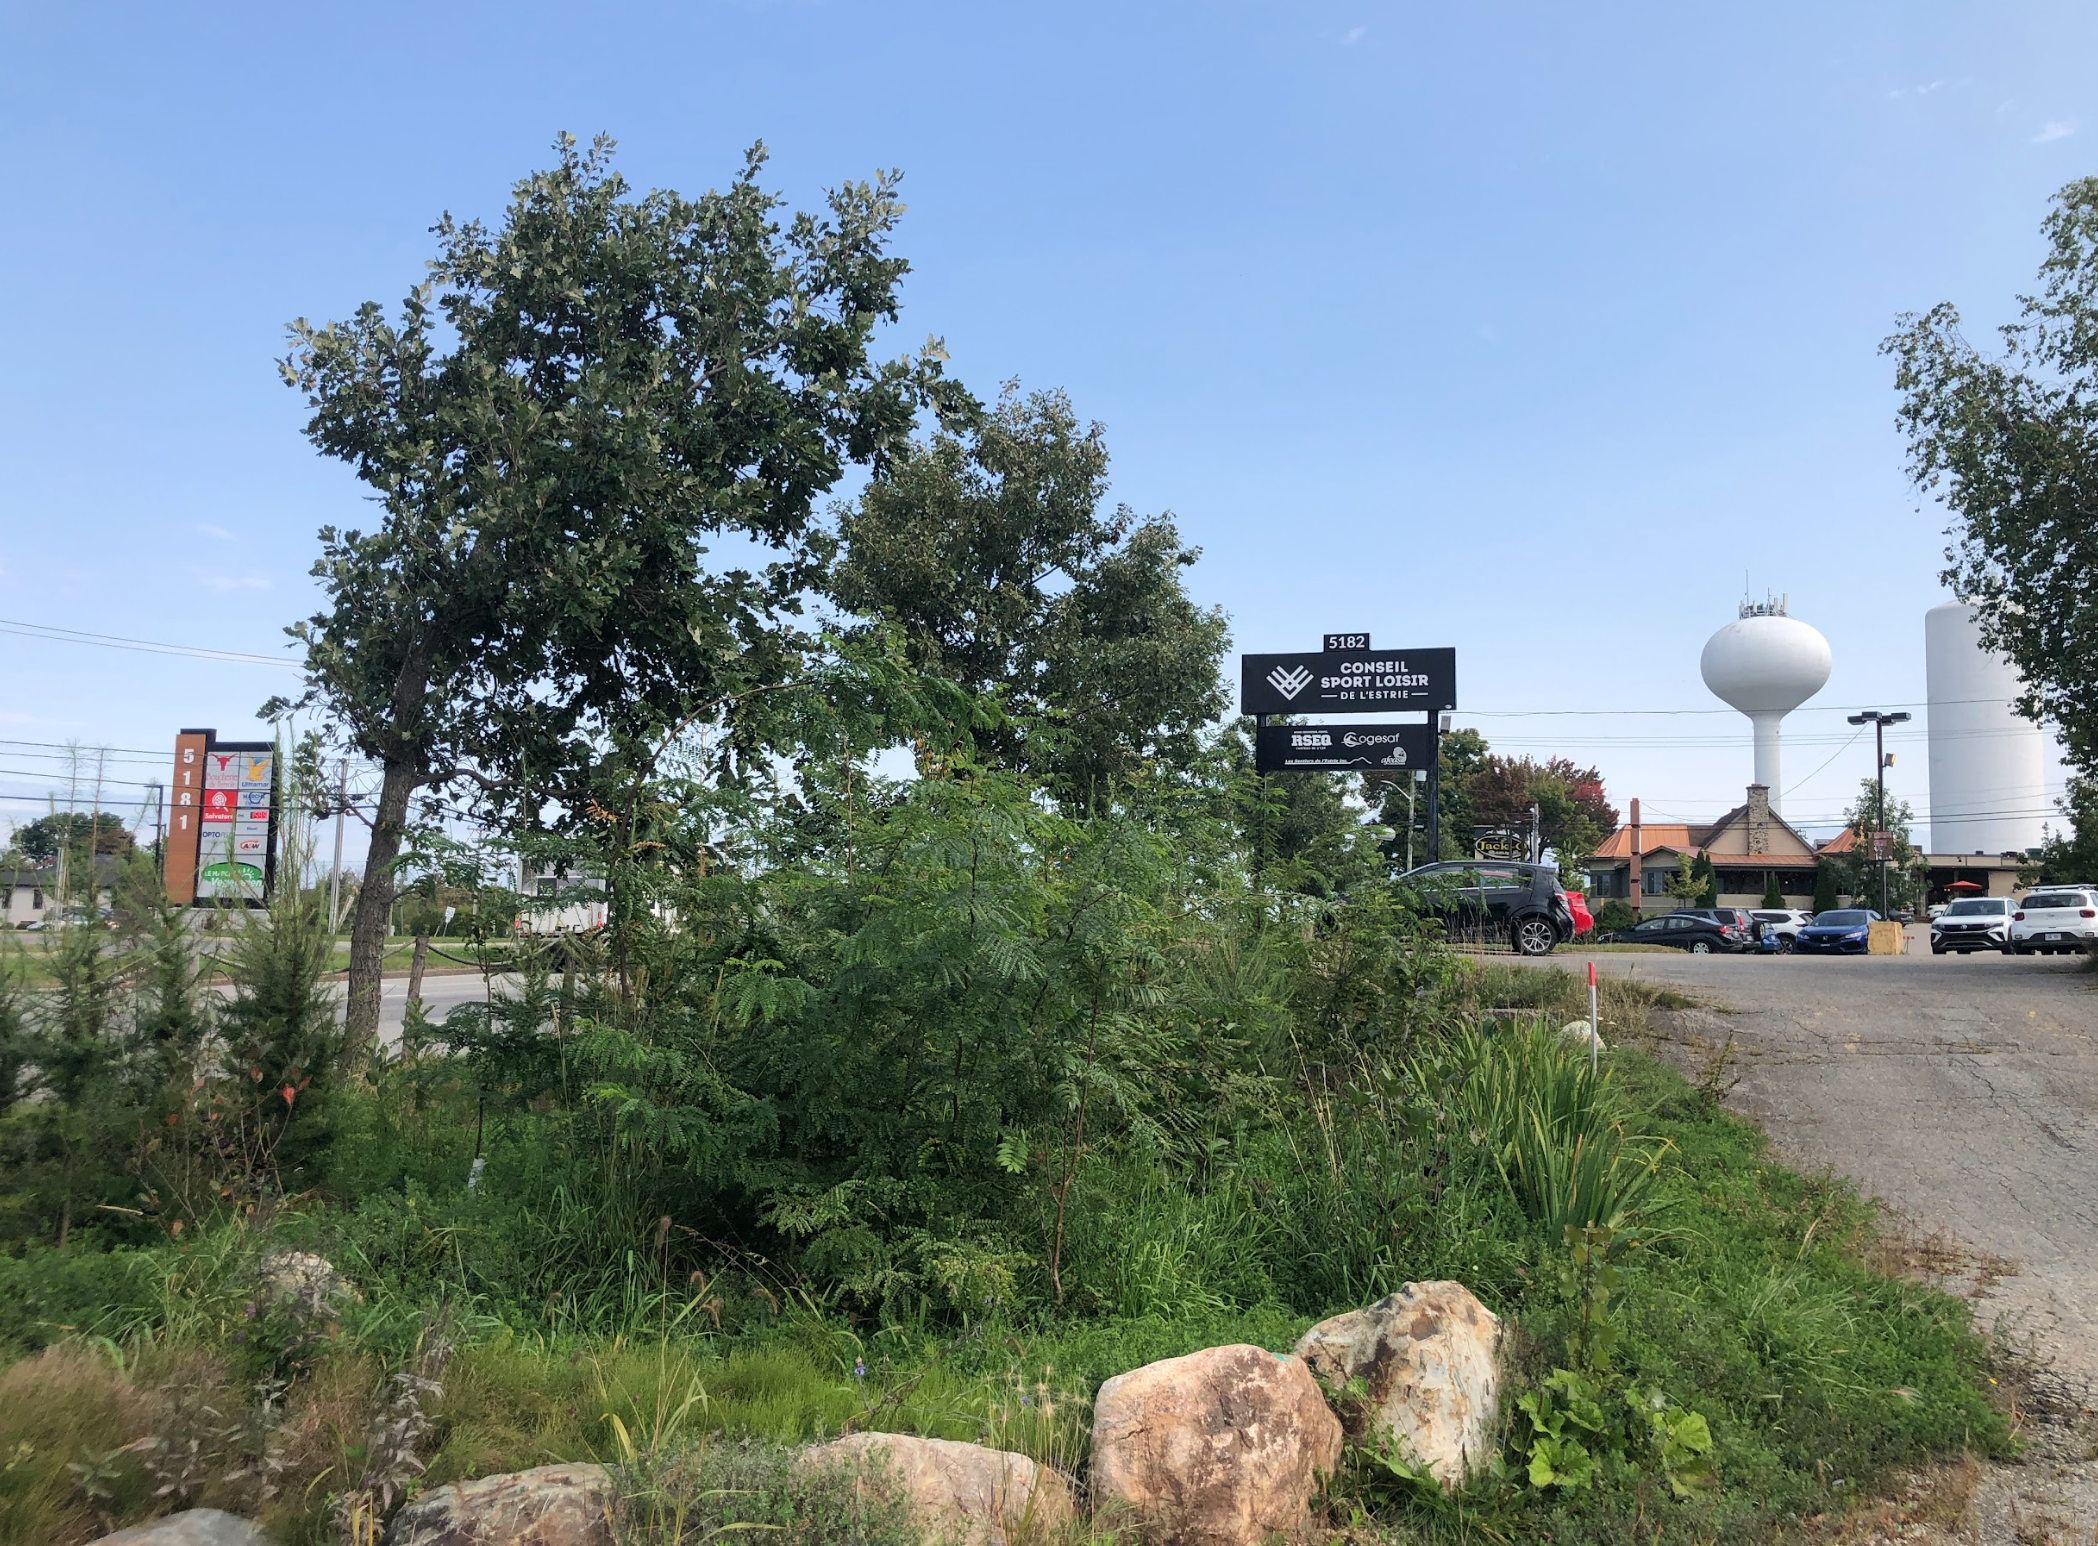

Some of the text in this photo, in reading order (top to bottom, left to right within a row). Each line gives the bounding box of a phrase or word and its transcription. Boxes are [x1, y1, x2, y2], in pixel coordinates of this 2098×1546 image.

[1329, 635, 1365, 648] 5182
[1340, 661, 1409, 674] CONSEIL
[1321, 674, 1429, 688] SPORT LOISIR
[1340, 690, 1409, 700] DE L'ESTRIE
[1291, 734, 1333, 747] RSEQ
